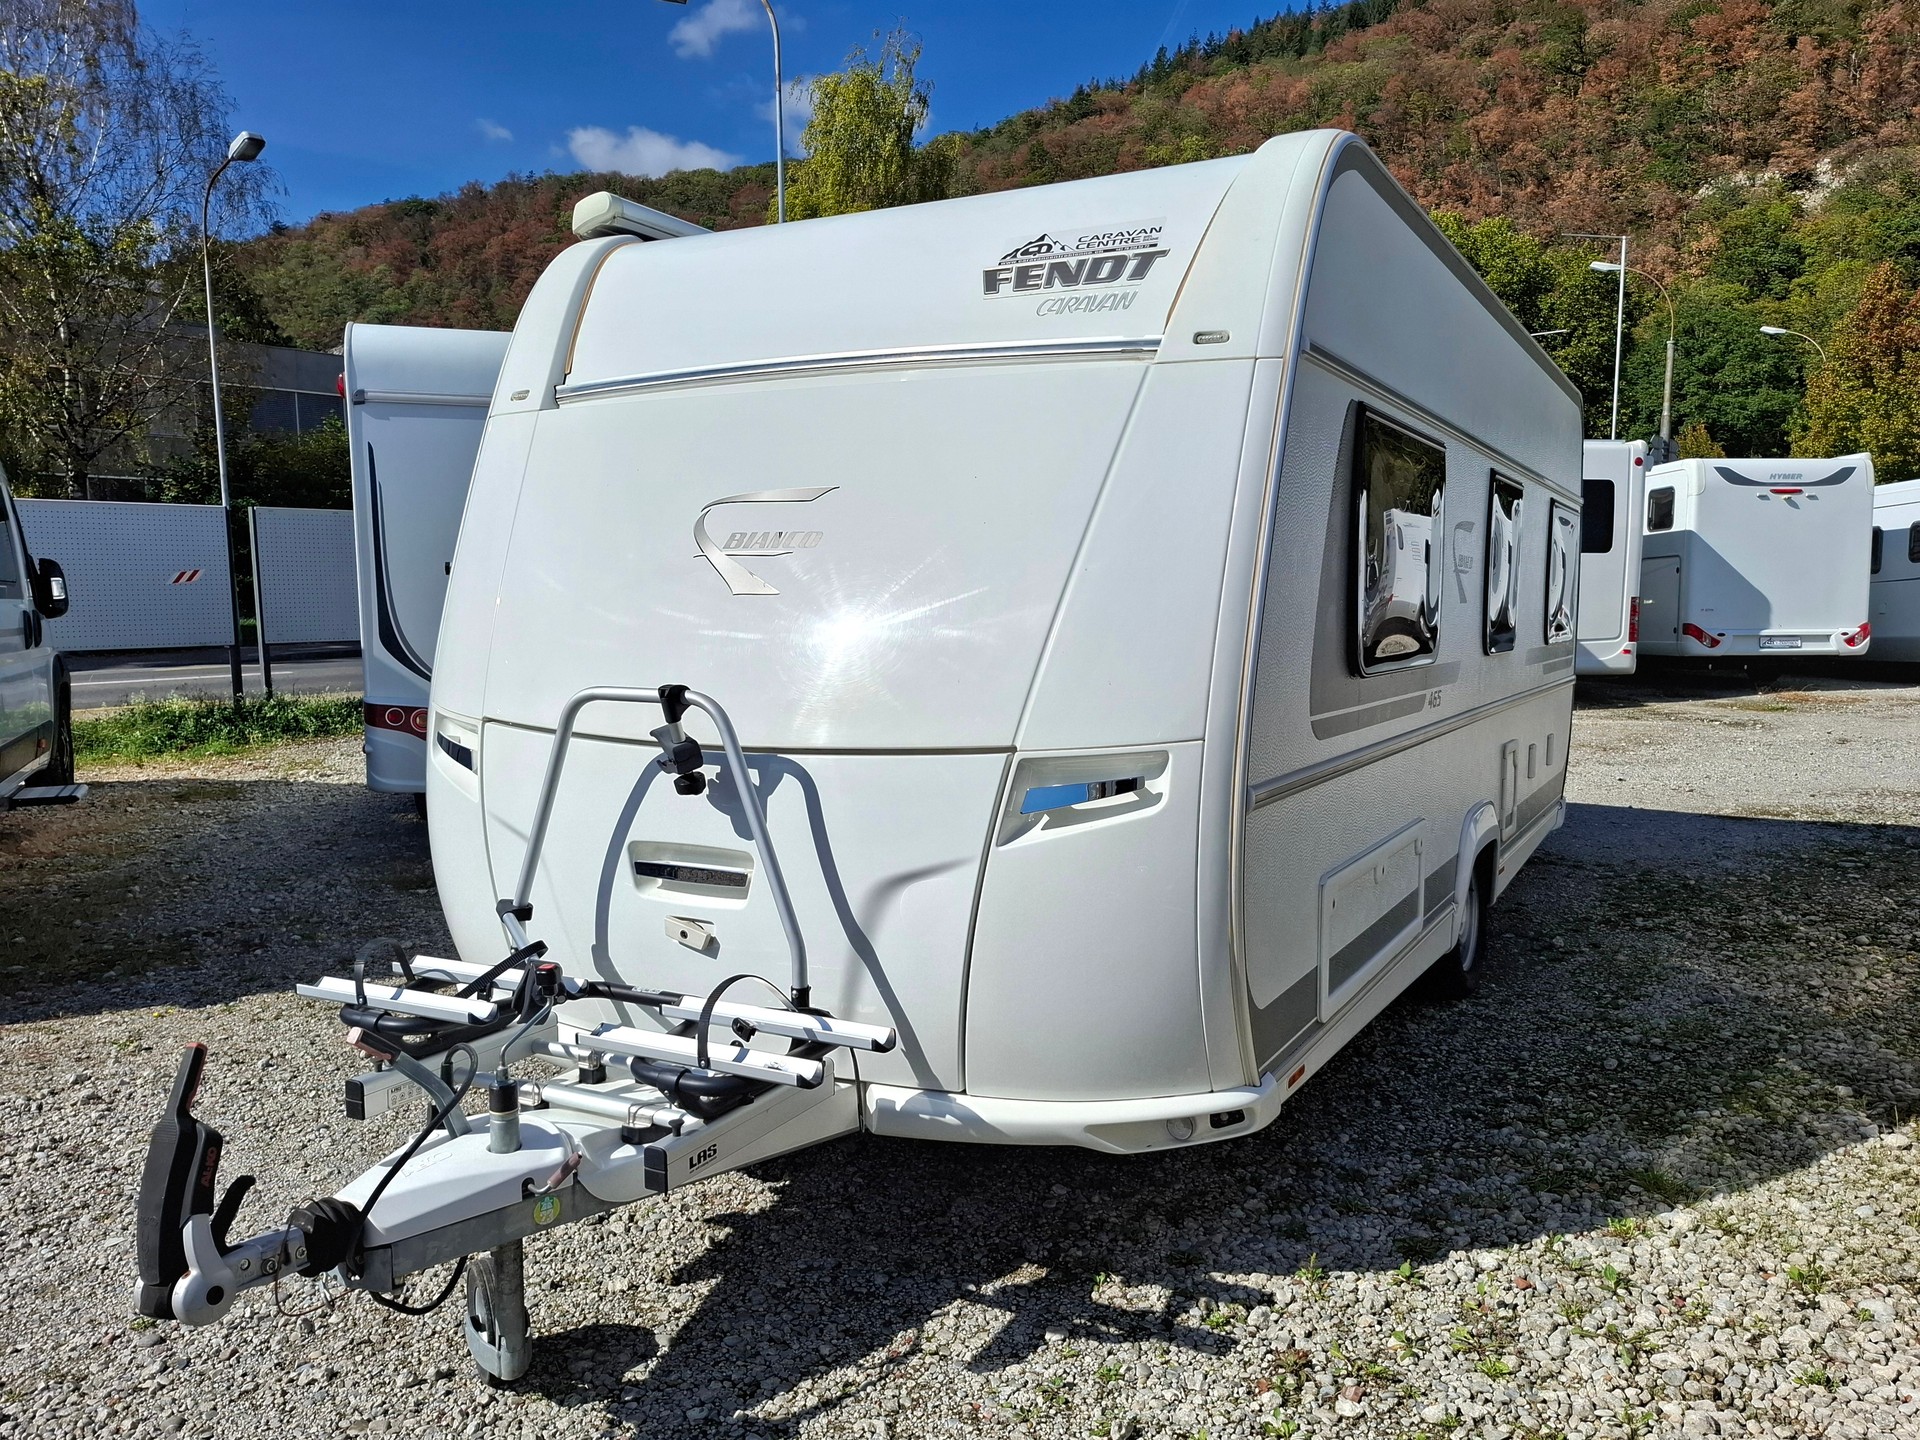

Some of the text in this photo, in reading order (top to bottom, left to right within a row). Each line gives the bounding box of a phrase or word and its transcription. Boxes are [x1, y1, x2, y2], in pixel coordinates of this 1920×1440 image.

[1075, 235, 1142, 250] CENTRE
[1078, 226, 1163, 243] CARAVAN
[983, 248, 1171, 296] FENDT
[1036, 289, 1139, 317] CARAVAN
[1769, 473, 1803, 481] HYMER
[722, 530, 825, 550] BIANCO
[1428, 689, 1442, 709] 465
[688, 1143, 718, 1170] LAS
